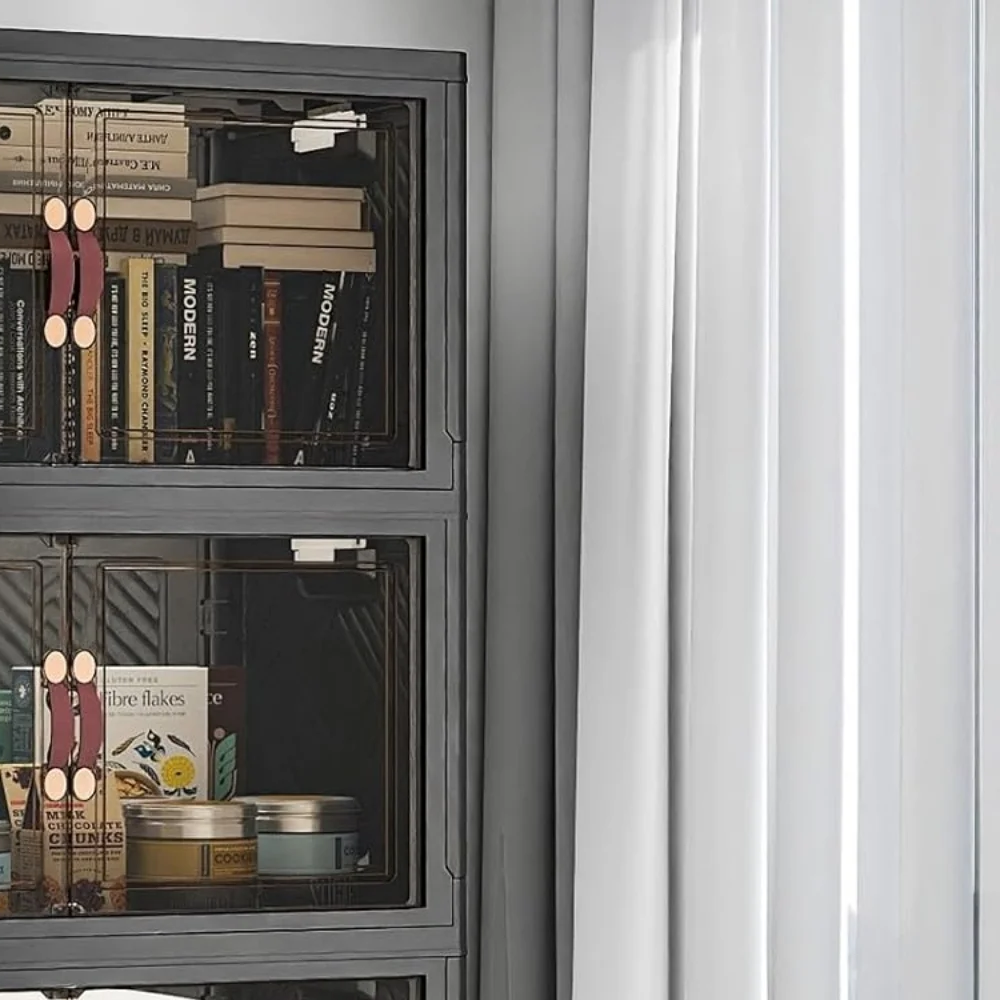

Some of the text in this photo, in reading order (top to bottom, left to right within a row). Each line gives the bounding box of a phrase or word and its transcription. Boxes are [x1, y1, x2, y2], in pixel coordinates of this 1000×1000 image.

[141, 271, 149, 289] THE
[141, 292, 149, 308] BIG
[141, 312, 149, 338] SLEEP
[183, 278, 197, 361] MODERN
[311, 283, 336, 365] MODERN
[15, 300, 26, 370] Conversations
[249, 331, 258, 360] zen
[16, 372, 25, 393] with
[141, 350, 149, 398] RAYMOND
[105, 689, 187, 707] ibre flakes
